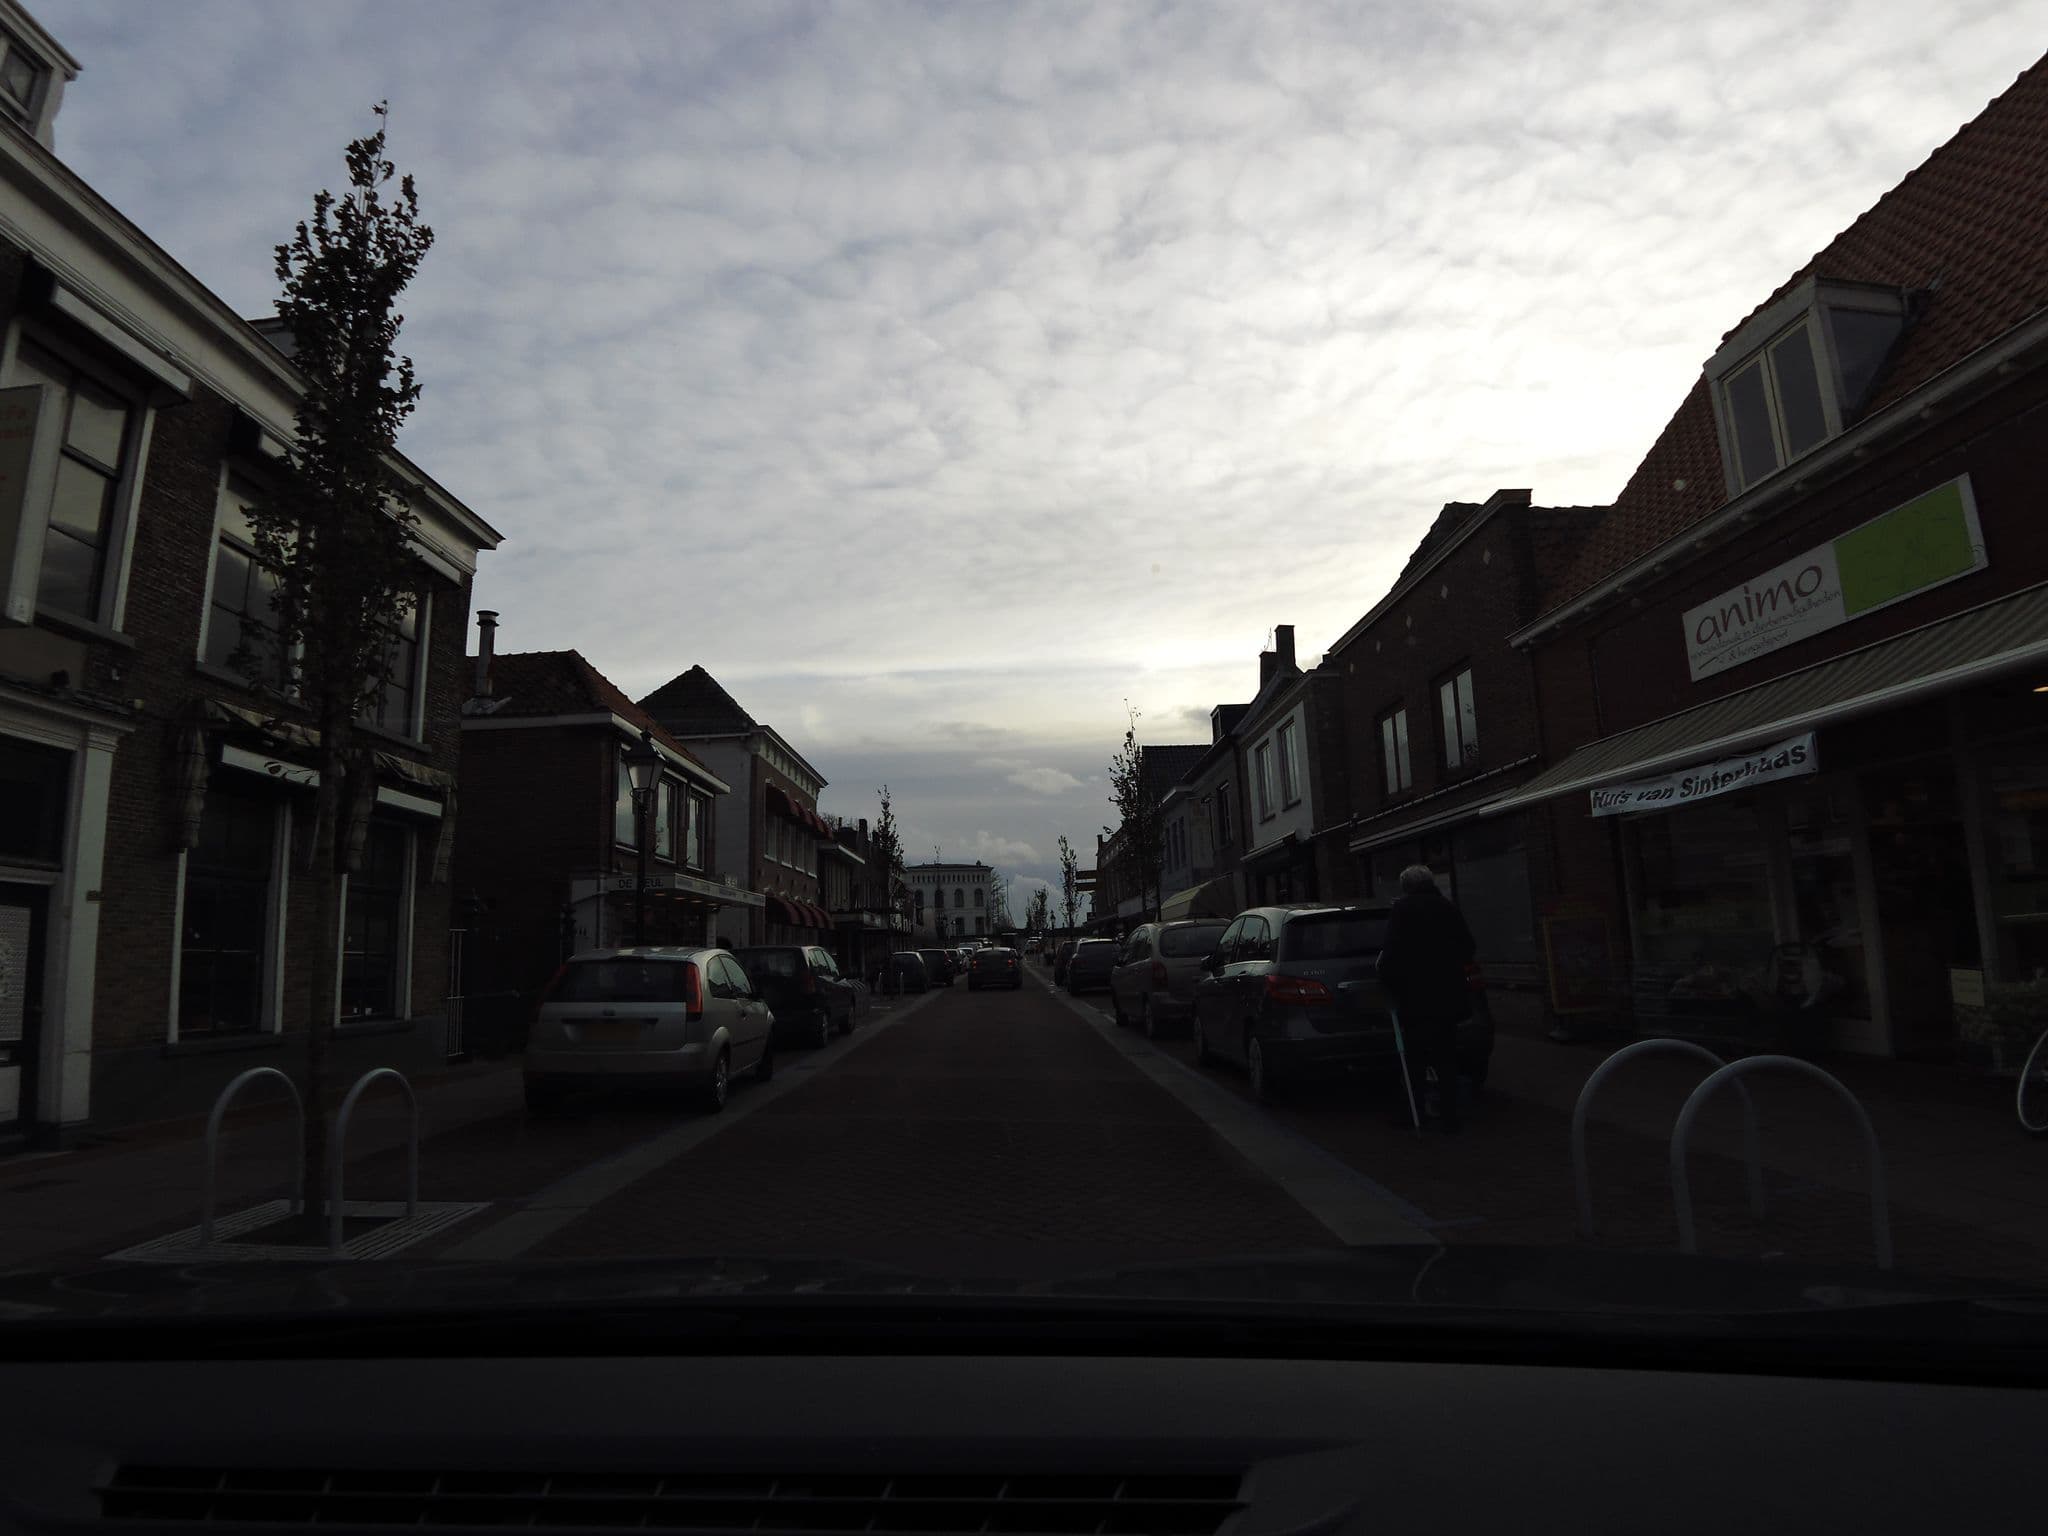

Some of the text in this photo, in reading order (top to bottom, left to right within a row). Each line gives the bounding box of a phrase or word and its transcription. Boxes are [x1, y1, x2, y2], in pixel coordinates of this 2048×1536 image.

[1696, 566, 1823, 645] animo
[1592, 790, 1633, 808] Huis
[1636, 787, 1675, 802] van
[618, 878, 632, 888] DE
